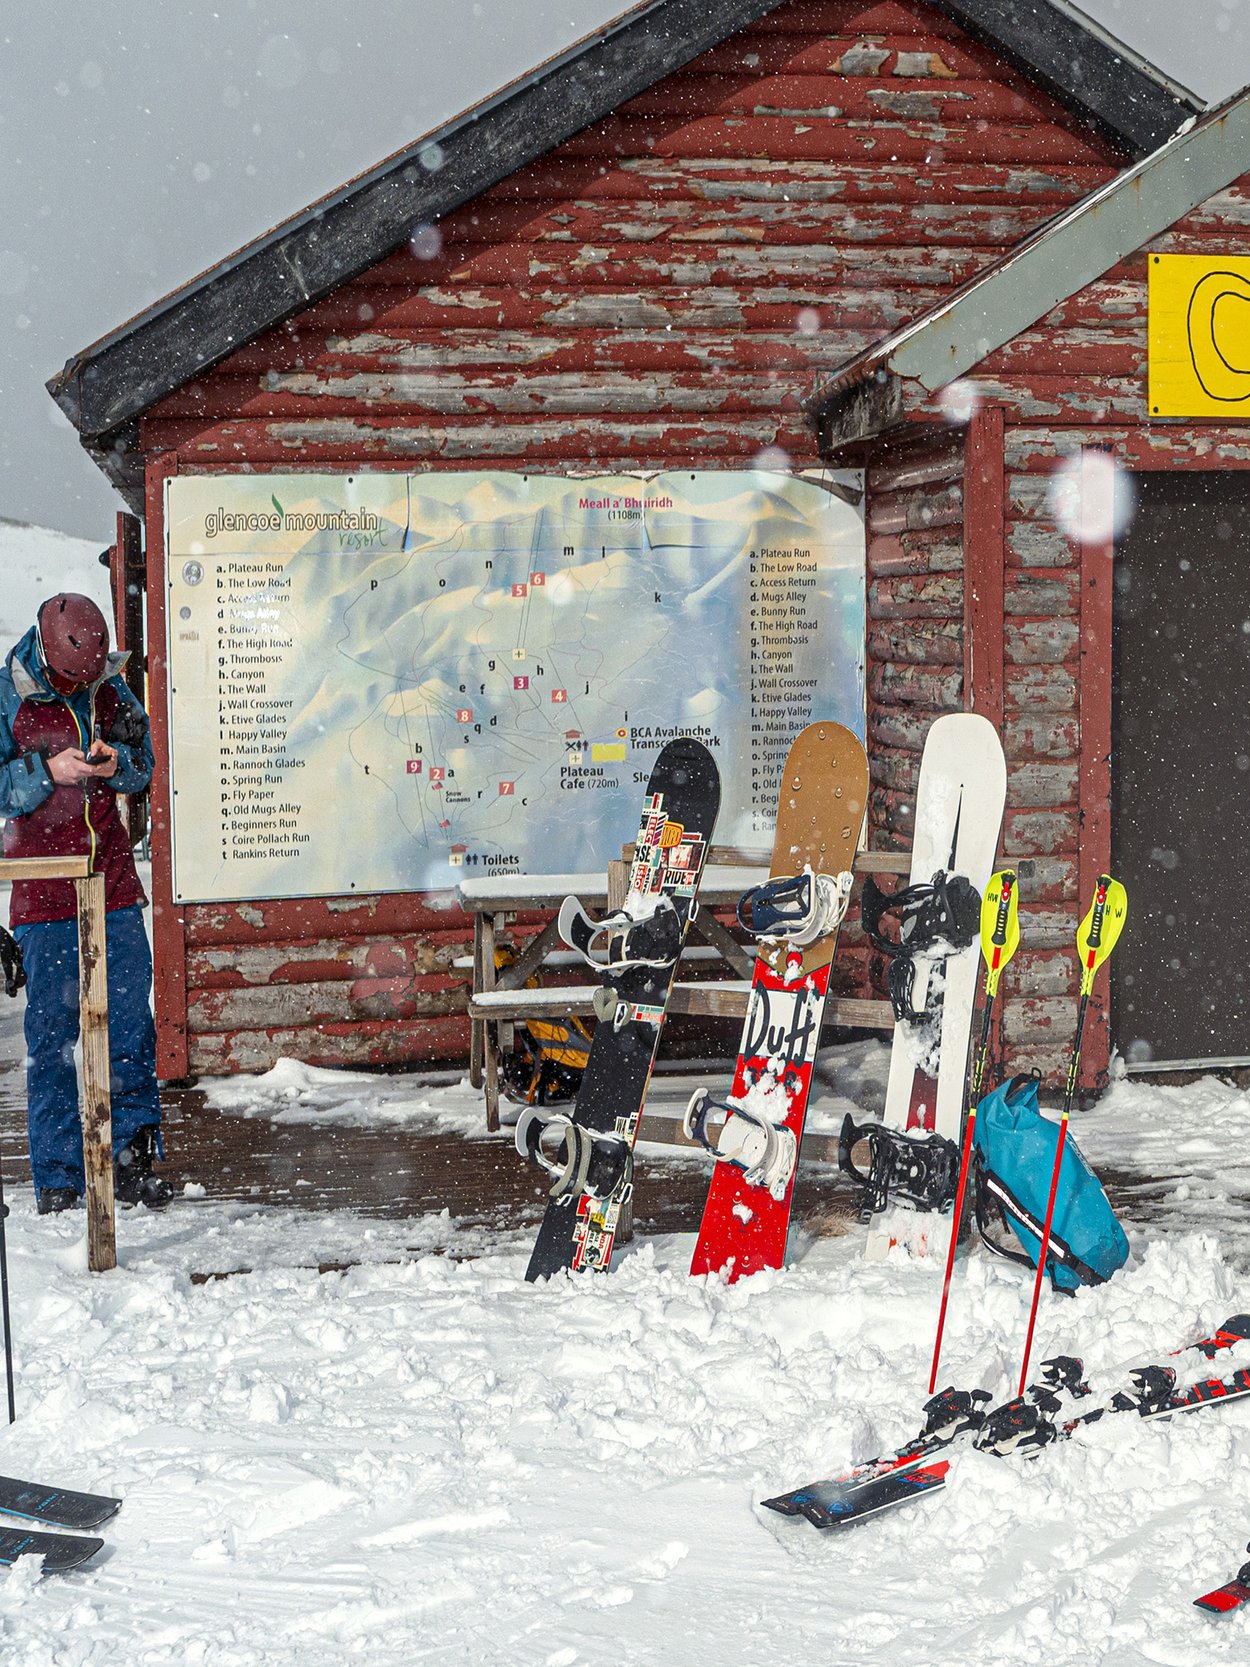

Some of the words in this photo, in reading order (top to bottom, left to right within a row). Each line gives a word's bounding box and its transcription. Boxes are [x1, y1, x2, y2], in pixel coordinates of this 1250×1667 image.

[579, 498, 610, 509] Meall
[625, 497, 673, 508] Bhuiridh
[608, 510, 645, 521] (1108m)
[205, 507, 281, 537] glencoe
[285, 507, 377, 530] mountain
[338, 518, 388, 547] resort
[761, 549, 791, 558] Plateau
[794, 548, 810, 557] Run
[229, 564, 263, 572] Plateau
[266, 563, 283, 572] Run
[750, 564, 758, 573] b.
[761, 563, 775, 572] The
[777, 563, 794, 572] Low
[797, 562, 817, 572] Road
[229, 578, 244, 588] The
[247, 578, 265, 588] Low
[268, 578, 291, 587] Road
[760, 578, 786, 587] Access
[789, 578, 816, 586] Return
[750, 593, 759, 601] d.
[762, 592, 784, 603] Mugs
[786, 592, 806, 603] Alley
[762, 607, 787, 617] Bunny
[790, 607, 805, 615] Run
[218, 626, 227, 634] e.
[751, 621, 757, 630] f.
[759, 621, 773, 630] The
[776, 621, 794, 632] High
[797, 620, 817, 629] Road
[218, 640, 224, 649] f.
[227, 639, 243, 648] The
[246, 639, 267, 650] High
[751, 638, 759, 647] g.
[761, 636, 808, 644] Thrombosis
[219, 657, 228, 666] g.
[230, 654, 282, 663] Thrombosis
[751, 651, 760, 659] h.
[762, 650, 792, 661] Canyon
[751, 665, 757, 674] i.
[759, 665, 773, 673] The
[775, 664, 793, 673] Wall
[219, 670, 228, 679] h.
[231, 670, 264, 680] Canyon
[219, 685, 225, 694] i.
[228, 685, 244, 694] The
[246, 684, 266, 693] Wall
[751, 679, 757, 690] j.
[759, 679, 777, 688] Wall
[779, 678, 817, 687] Crossover
[752, 694, 759, 703] k.
[762, 693, 781, 702] Etive
[784, 693, 811, 701] Glades
[218, 700, 225, 712] j.
[228, 700, 247, 709] Wall
[251, 699, 293, 708] Crossover
[760, 708, 785, 718] Happy
[787, 707, 812, 717] Valley
[220, 716, 228, 725] k.
[232, 715, 253, 724] Etive
[256, 714, 286, 724] Glades
[631, 727, 652, 737] BCA
[655, 726, 711, 737] Avalanche
[766, 722, 786, 731] Main
[229, 730, 258, 740] Happy
[260, 729, 287, 739] Valley
[236, 745, 258, 754] Main
[262, 744, 286, 753] Basin
[233, 760, 272, 769] Rannoch
[275, 759, 305, 768] Glades
[561, 767, 603, 777] Plateau
[233, 775, 262, 786] Spring
[265, 774, 282, 783] Run
[561, 779, 585, 789] Cafe
[588, 778, 619, 789] (720m)
[222, 793, 230, 802] p.
[233, 791, 246, 801] Fly
[249, 790, 274, 800] Paper
[222, 808, 231, 817] q.
[234, 805, 248, 814] Old
[252, 805, 276, 816] Mugs
[279, 803, 301, 814] Alley
[232, 821, 276, 832] Beginners
[280, 819, 296, 828] Run
[233, 835, 254, 845] Coire
[258, 834, 290, 844] Pollach
[292, 833, 310, 842] Run
[233, 850, 266, 859] Rankins
[269, 848, 299, 858] Return
[482, 855, 519, 865] Toilets
